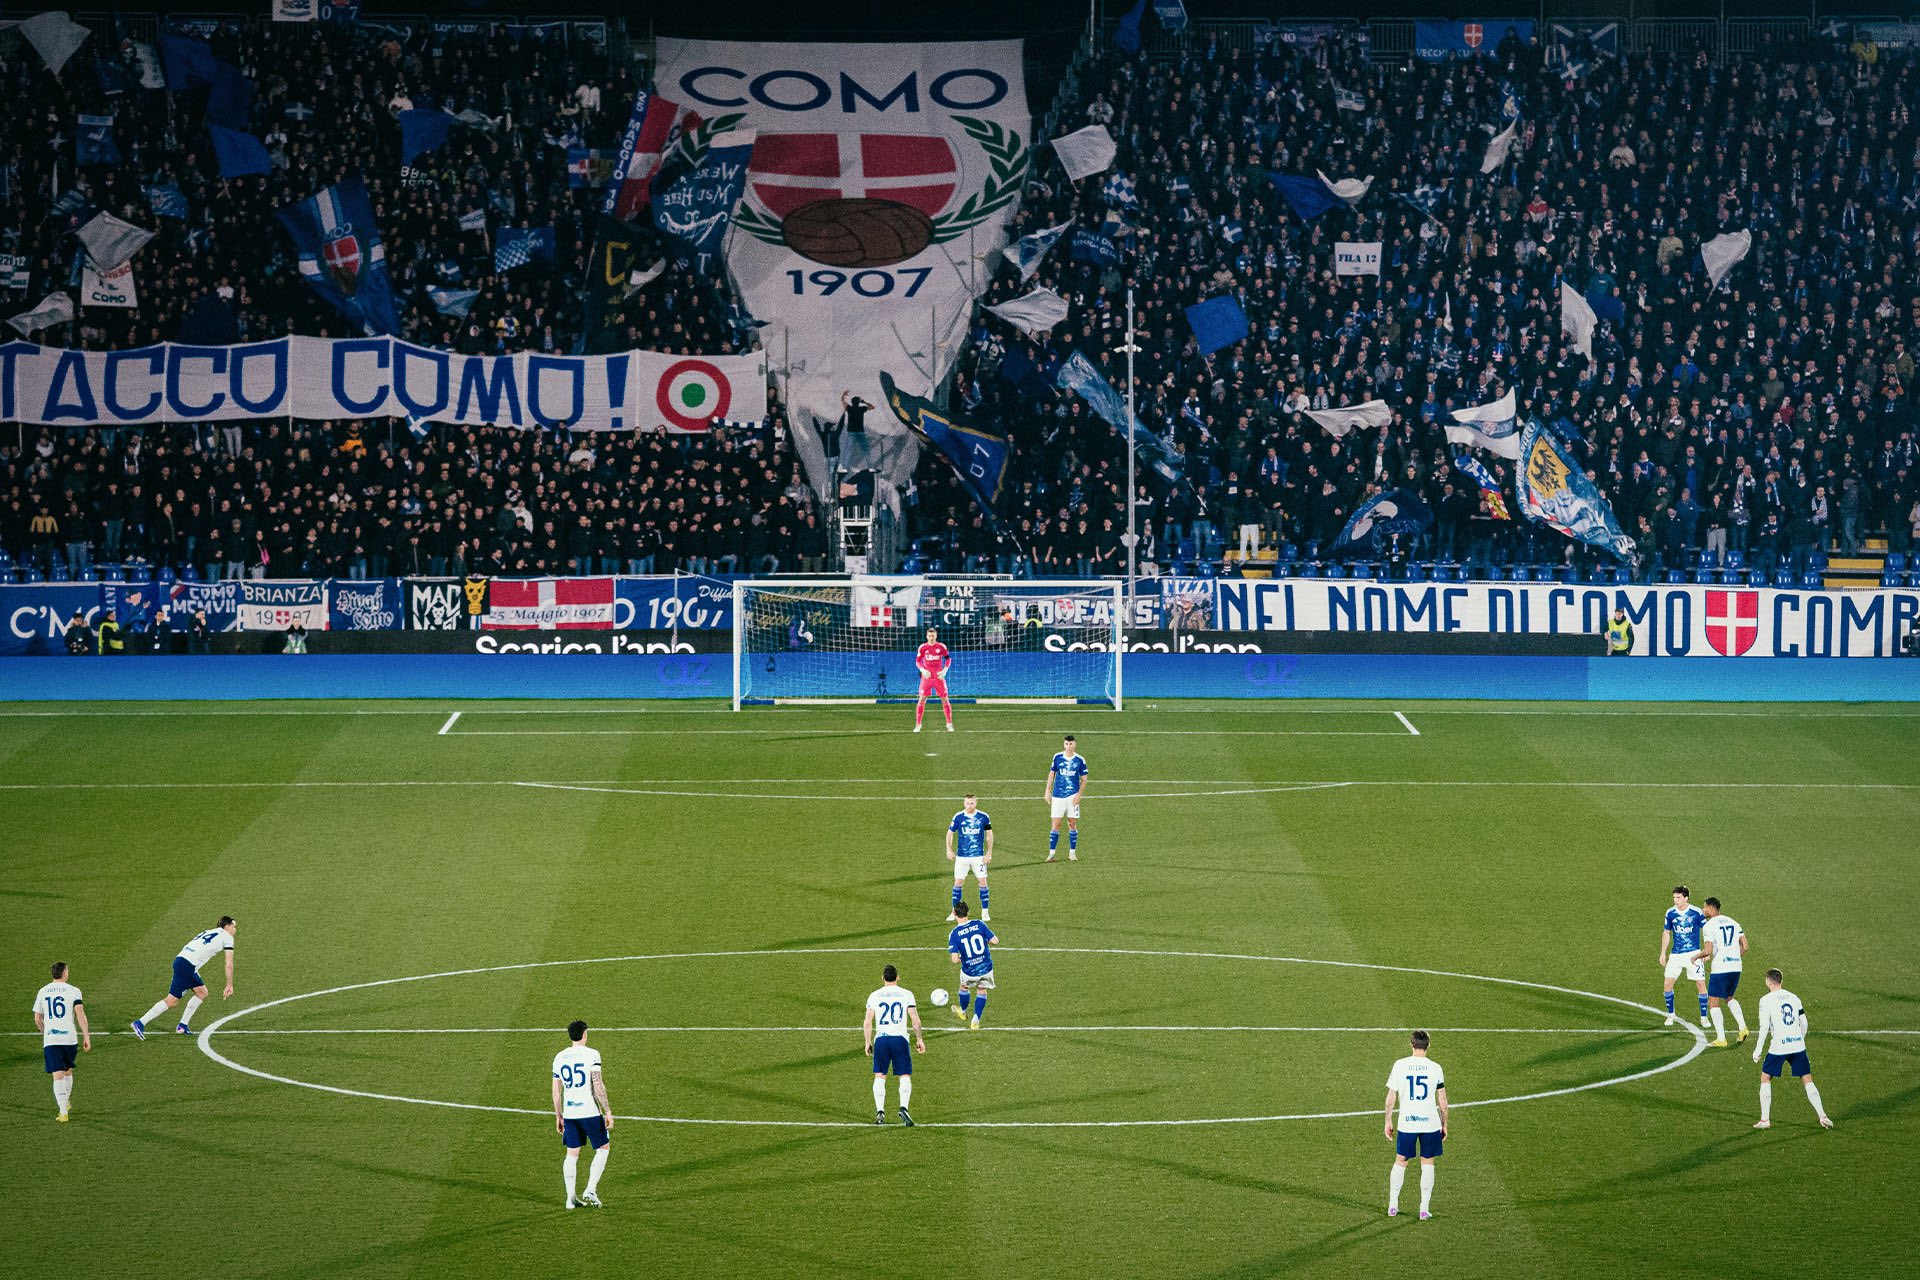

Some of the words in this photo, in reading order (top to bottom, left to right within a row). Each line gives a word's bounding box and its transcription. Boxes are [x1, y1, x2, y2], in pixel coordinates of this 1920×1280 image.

[679, 66, 1009, 113] COMO
[613, 119, 641, 180] MAGGIO
[1339, 253, 1361, 263] FILA
[1366, 253, 1377, 263] 12
[787, 267, 934, 298] 1907
[92, 291, 126, 303] COMO
[188, 585, 237, 601] COMO
[244, 584, 322, 604] BRIANZA
[255, 610, 274, 625] 19
[490, 611, 505, 620] 25
[511, 609, 568, 623] Maggio
[573, 608, 606, 618] 1907
[1328, 585, 1468, 633] NOME
[1549, 588, 1692, 657] COMO
[961, 933, 986, 958] 10
[1719, 925, 1735, 946] 17
[45, 996, 66, 1020] 16
[878, 1001, 904, 1025] 20
[1780, 1003, 1796, 1025] 8
[560, 1062, 587, 1089] 95
[1406, 1075, 1428, 1101] 15
